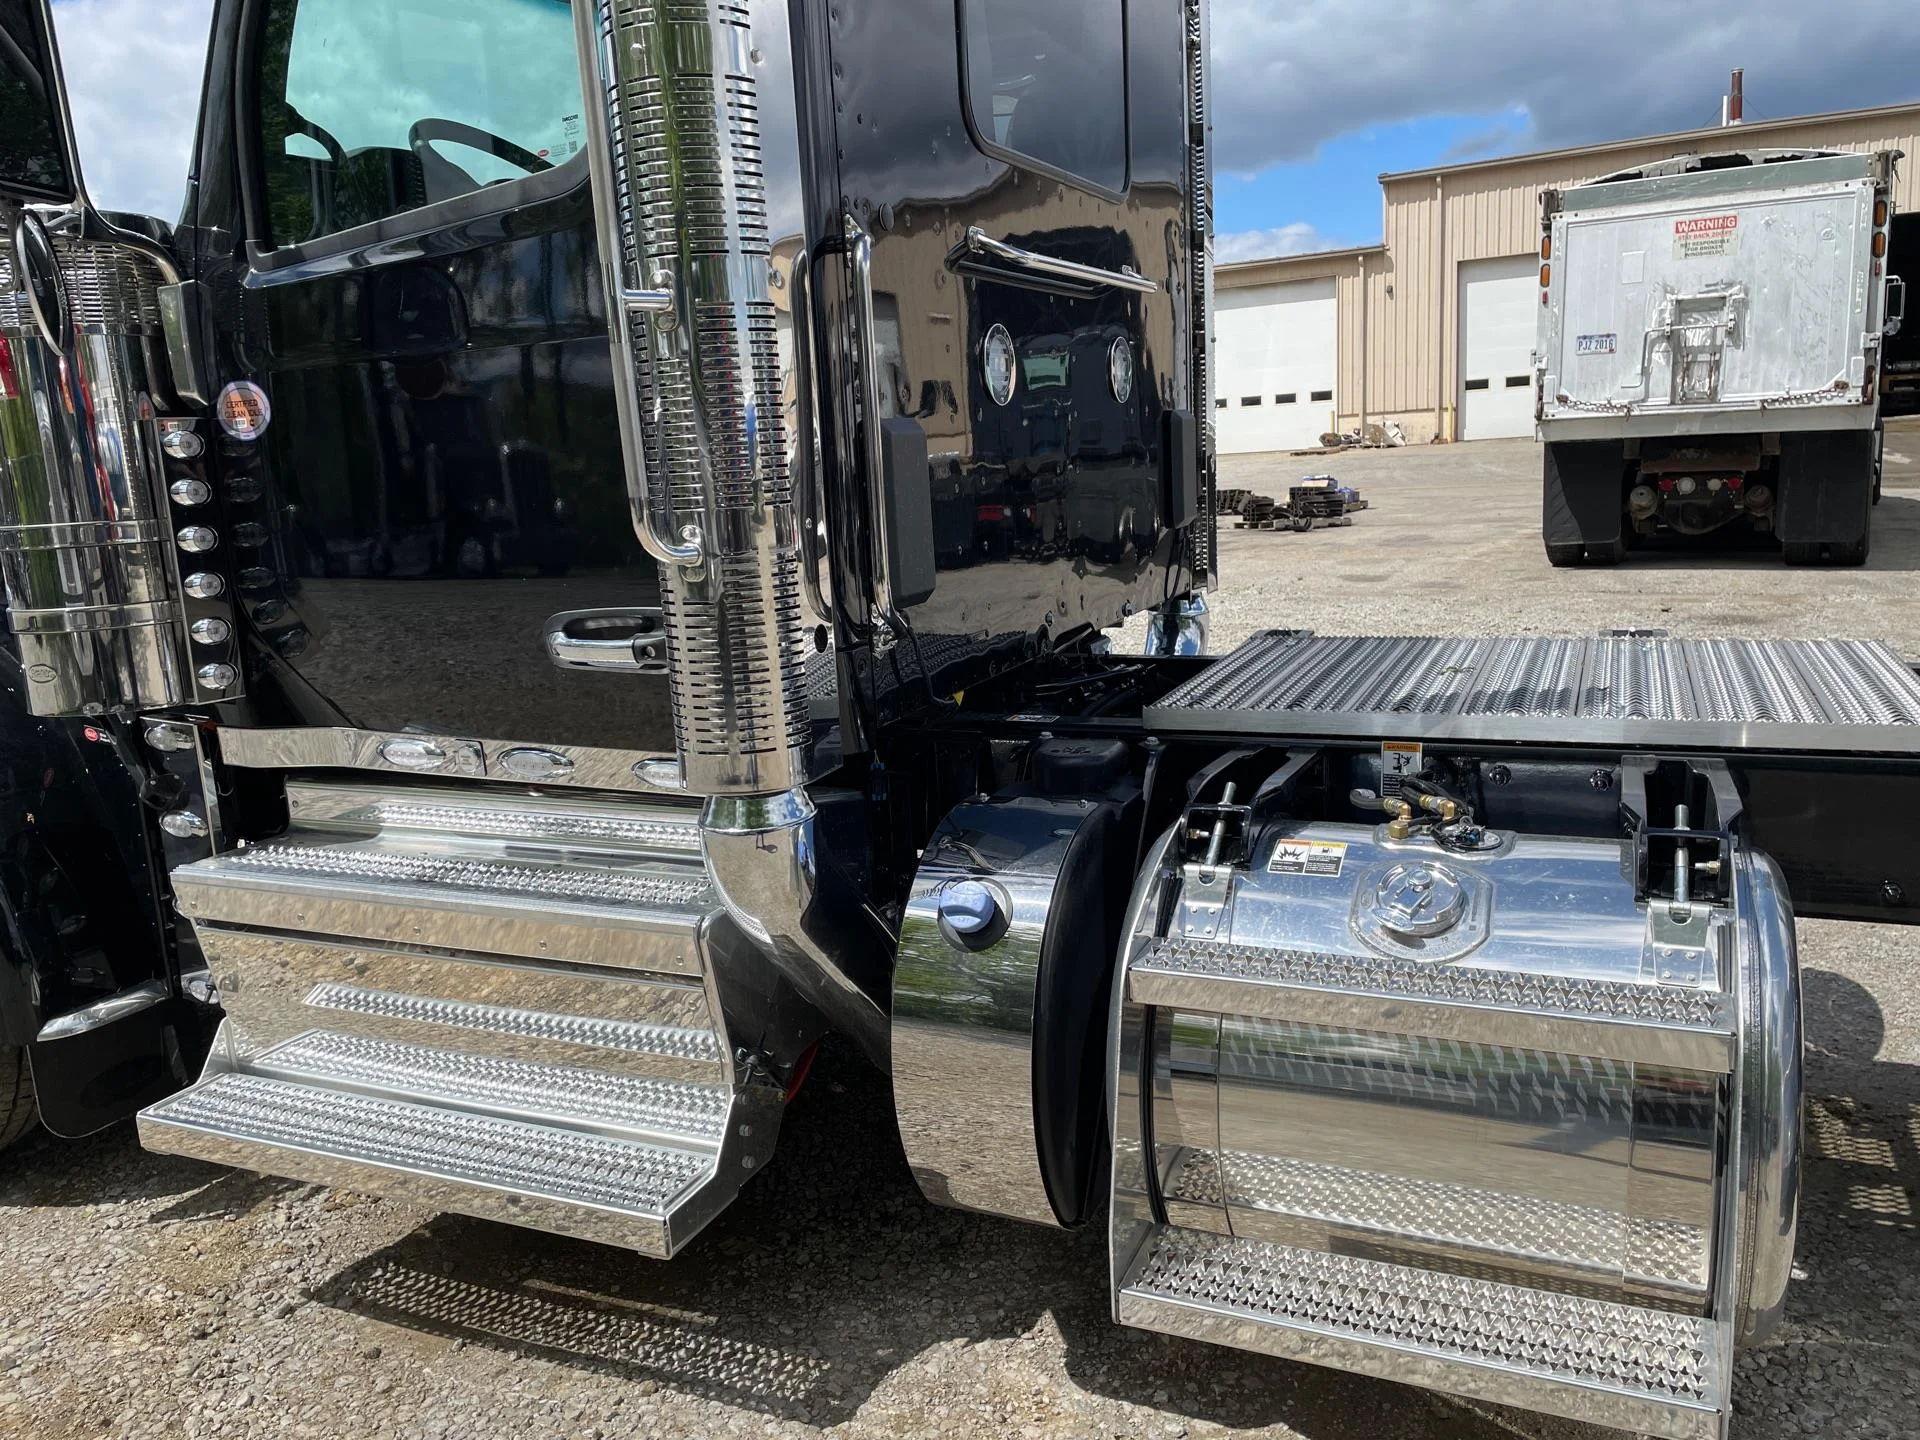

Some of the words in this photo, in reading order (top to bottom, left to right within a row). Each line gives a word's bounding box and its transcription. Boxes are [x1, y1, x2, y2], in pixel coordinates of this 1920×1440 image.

[1677, 217, 1736, 233] WARNING
[1578, 340, 1592, 351] PJZ
[1595, 339, 1614, 350] 2016
[226, 399, 258, 409] CERTIFIED
[225, 409, 246, 419] CLEAN
